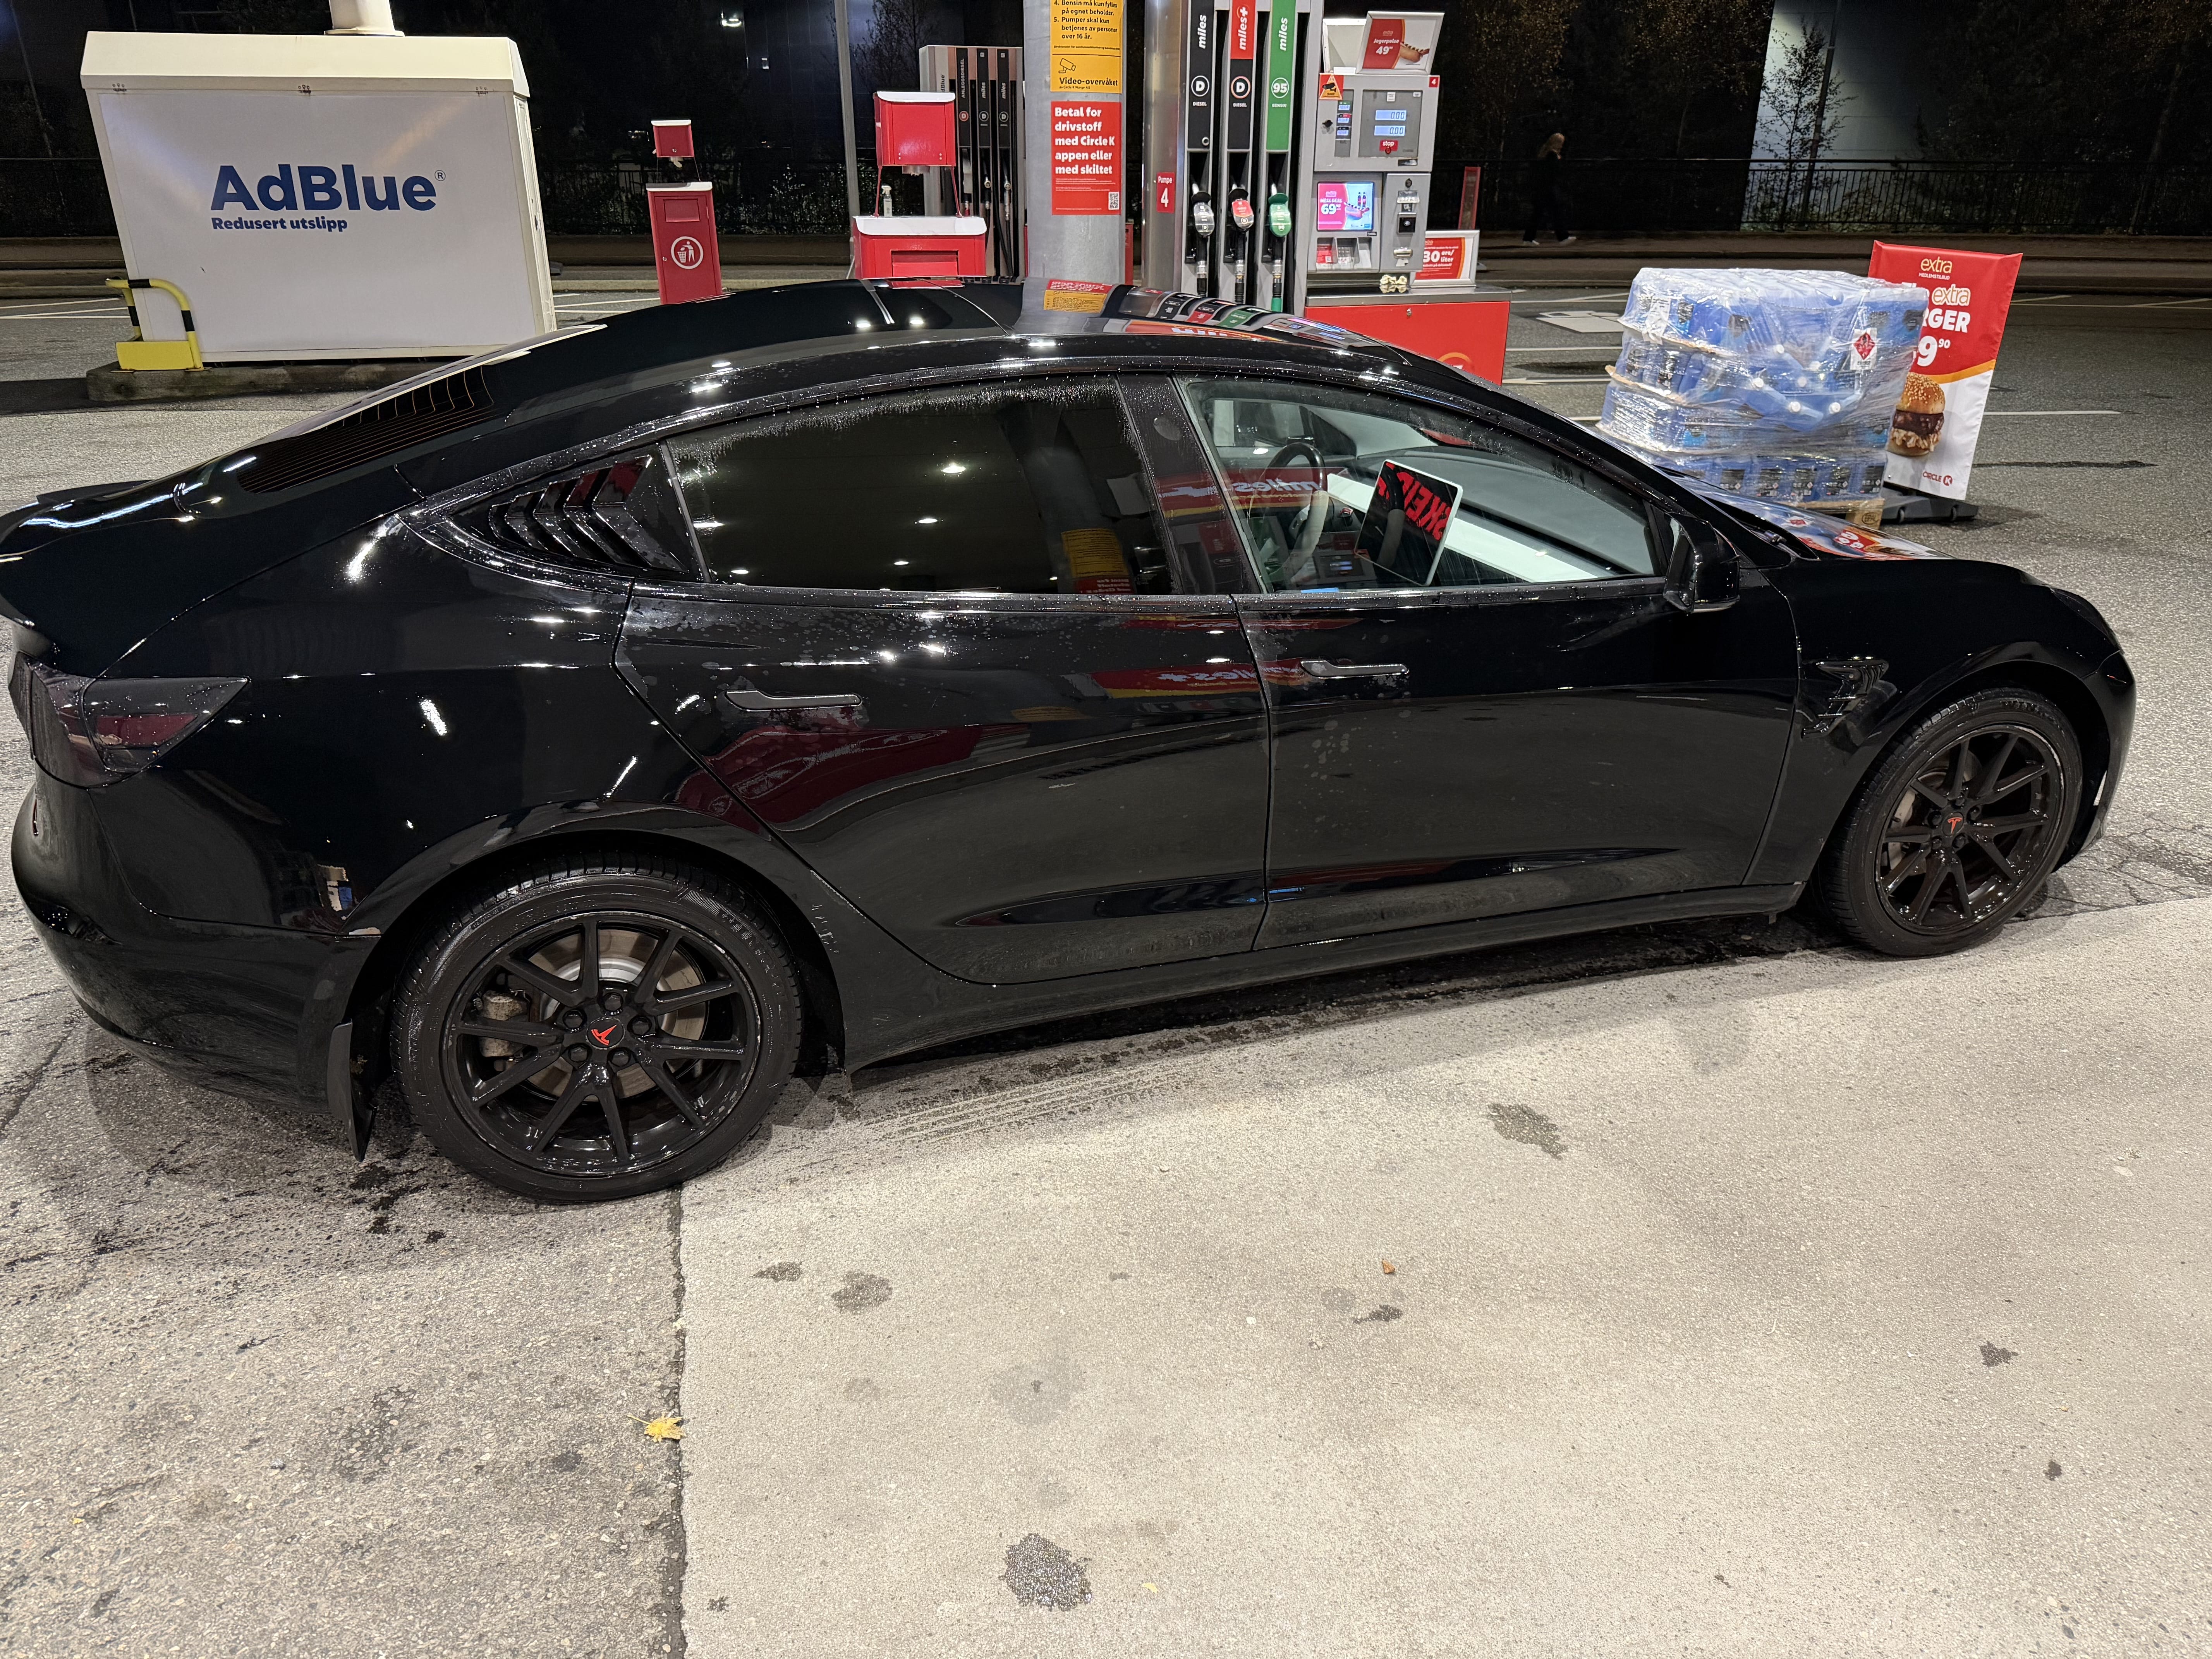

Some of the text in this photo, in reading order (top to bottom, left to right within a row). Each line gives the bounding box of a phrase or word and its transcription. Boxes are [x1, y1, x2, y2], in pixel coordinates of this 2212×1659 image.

[1197, 15, 1207, 49] miles
[1279, 17, 1288, 51] miles
[1376, 46, 1389, 55] 49
[1196, 81, 1205, 91] D
[1236, 82, 1245, 93] D
[1273, 83, 1287, 93] 95
[1055, 107, 1102, 117] Betal for
[1055, 121, 1102, 131] drivstoff
[1055, 135, 1115, 146] med Circle K
[1055, 150, 1112, 162] appen eller
[1055, 164, 1112, 174] med skiltet
[1161, 187, 1169, 207] 4
[1321, 204, 1336, 215] 69
[211, 216, 348, 232] Redusert utslipp
[1423, 251, 1440, 263] 30
[1920, 256, 1953, 273] extra
[1932, 283, 1971, 306] extra
[1913, 336, 1938, 367] 9
[1923, 471, 1953, 486] CIRCLE K
